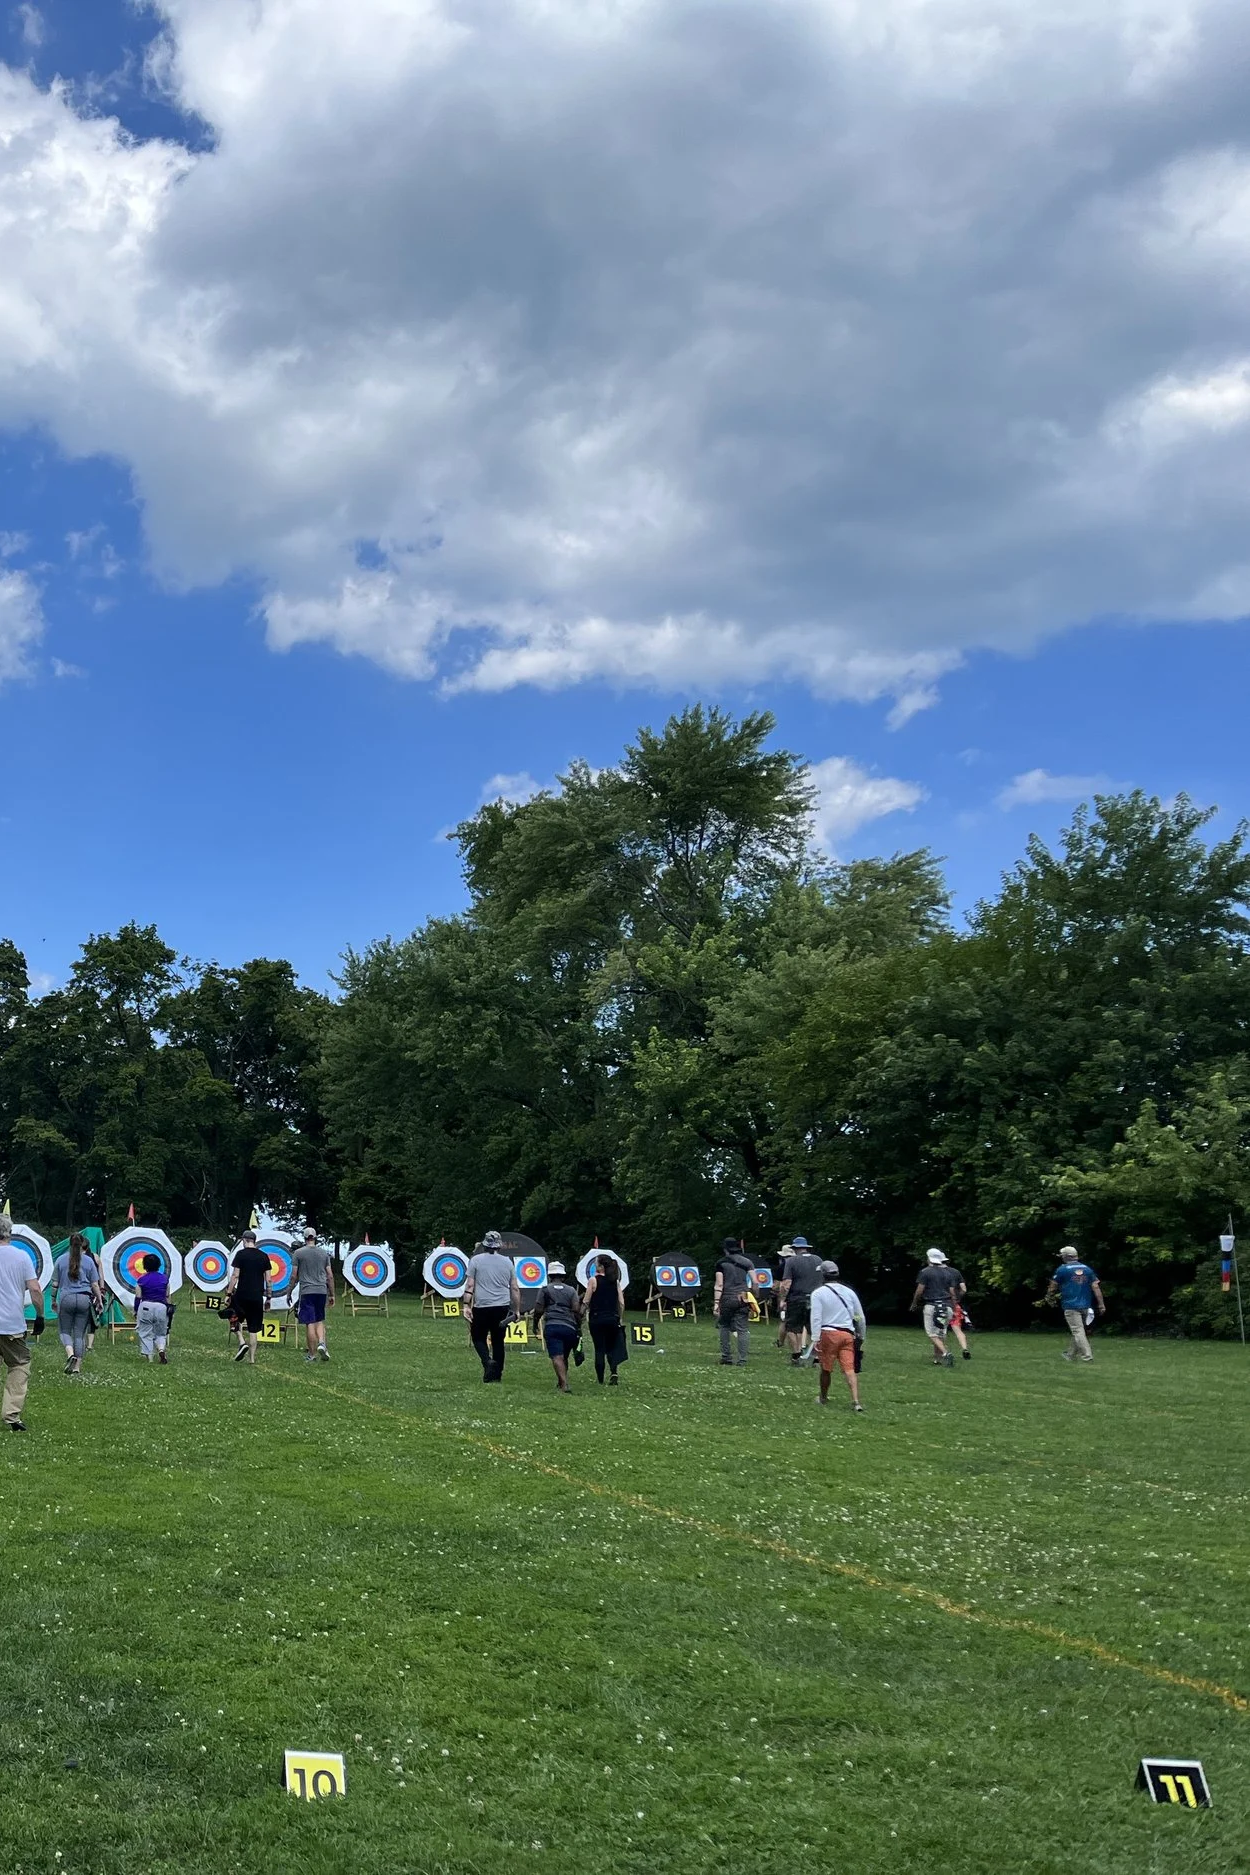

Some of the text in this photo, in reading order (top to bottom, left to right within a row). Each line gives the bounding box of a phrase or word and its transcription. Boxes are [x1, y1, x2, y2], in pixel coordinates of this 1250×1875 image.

[208, 1297, 219, 1308] 13
[445, 1304, 458, 1314] 16
[672, 1307, 686, 1318] 19
[507, 1324, 524, 1339] 14
[633, 1326, 653, 1342] 15
[293, 1767, 338, 1801] 10
[1158, 1774, 1199, 1809] 11
